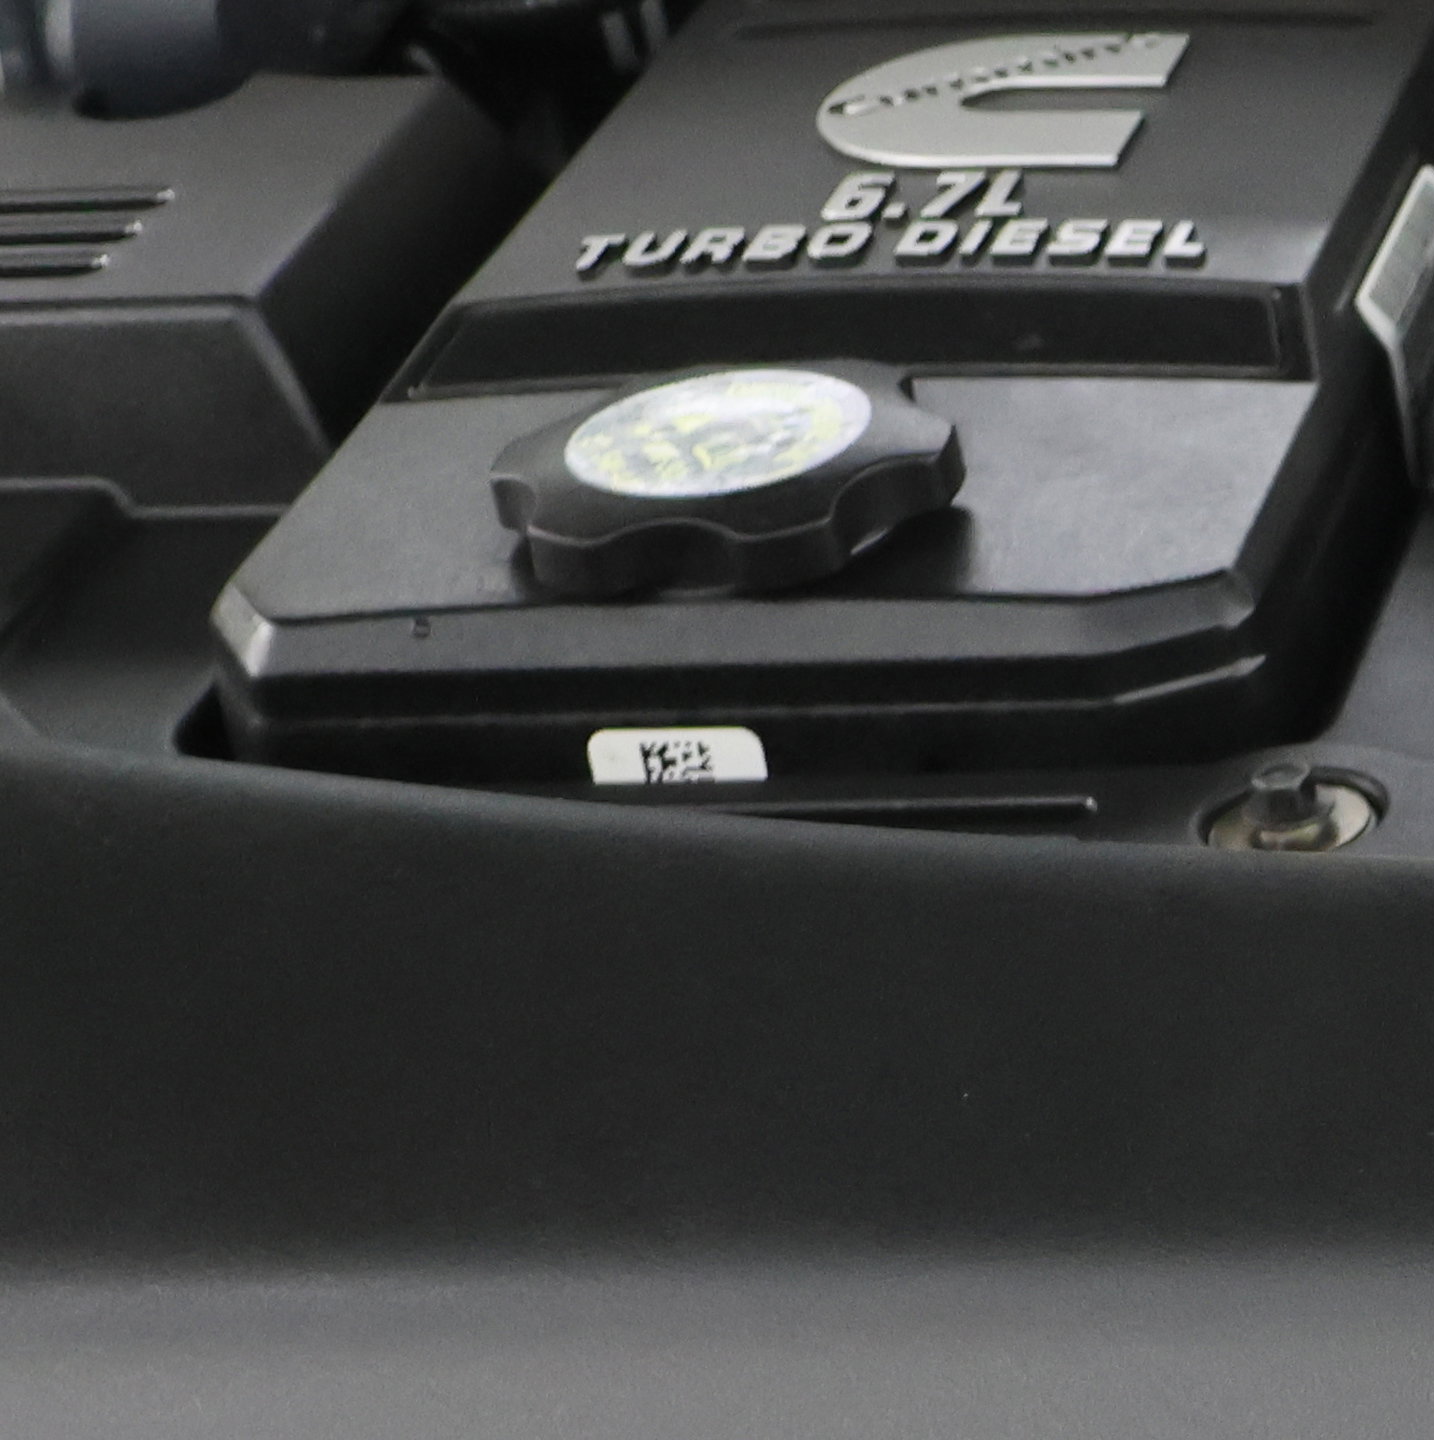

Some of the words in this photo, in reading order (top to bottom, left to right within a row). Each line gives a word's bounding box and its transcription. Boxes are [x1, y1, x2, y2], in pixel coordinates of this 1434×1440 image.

[820, 169, 1026, 222] 6.7L
[575, 220, 873, 272] TURBO
[893, 217, 1207, 260] DIESEL
